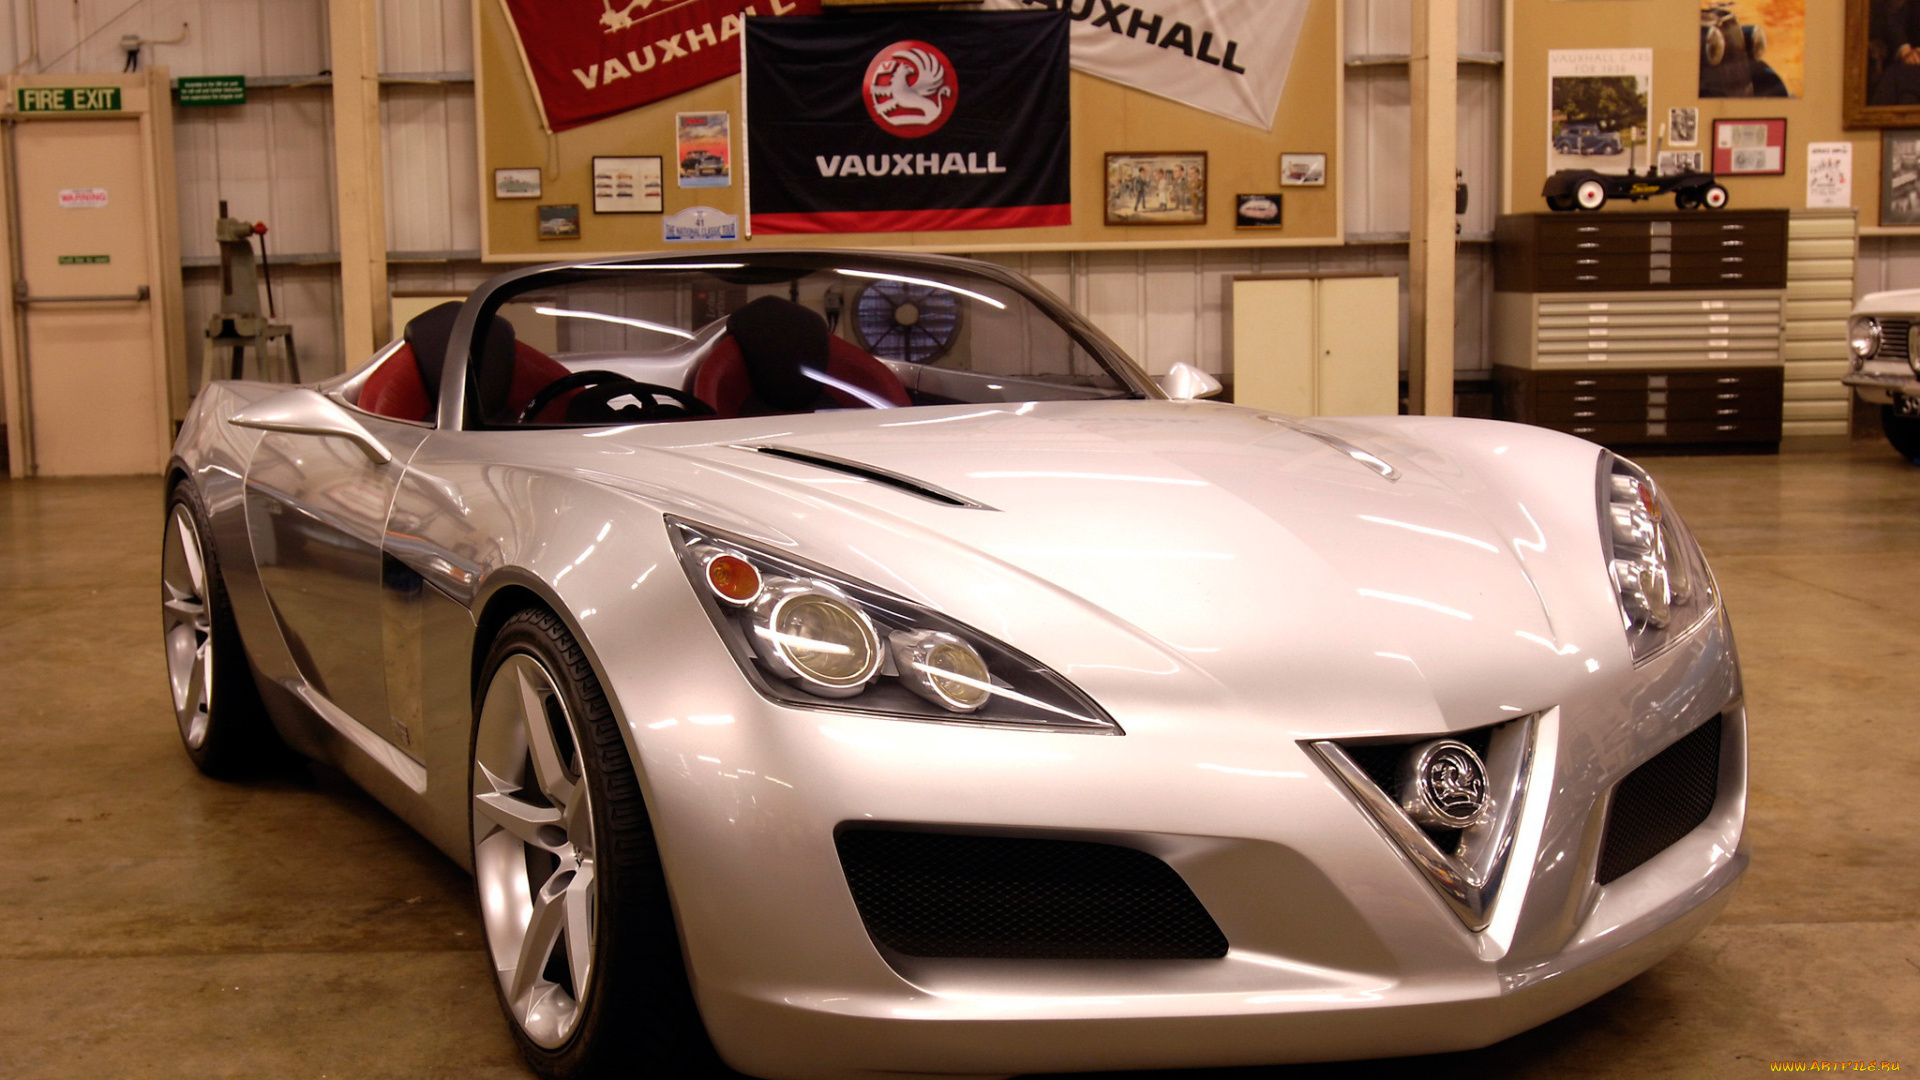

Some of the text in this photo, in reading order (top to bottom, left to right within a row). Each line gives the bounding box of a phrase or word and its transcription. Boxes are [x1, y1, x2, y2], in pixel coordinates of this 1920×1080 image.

[24, 88, 115, 110] FIRE EXIT
[815, 151, 1007, 178] VAUXHALL
